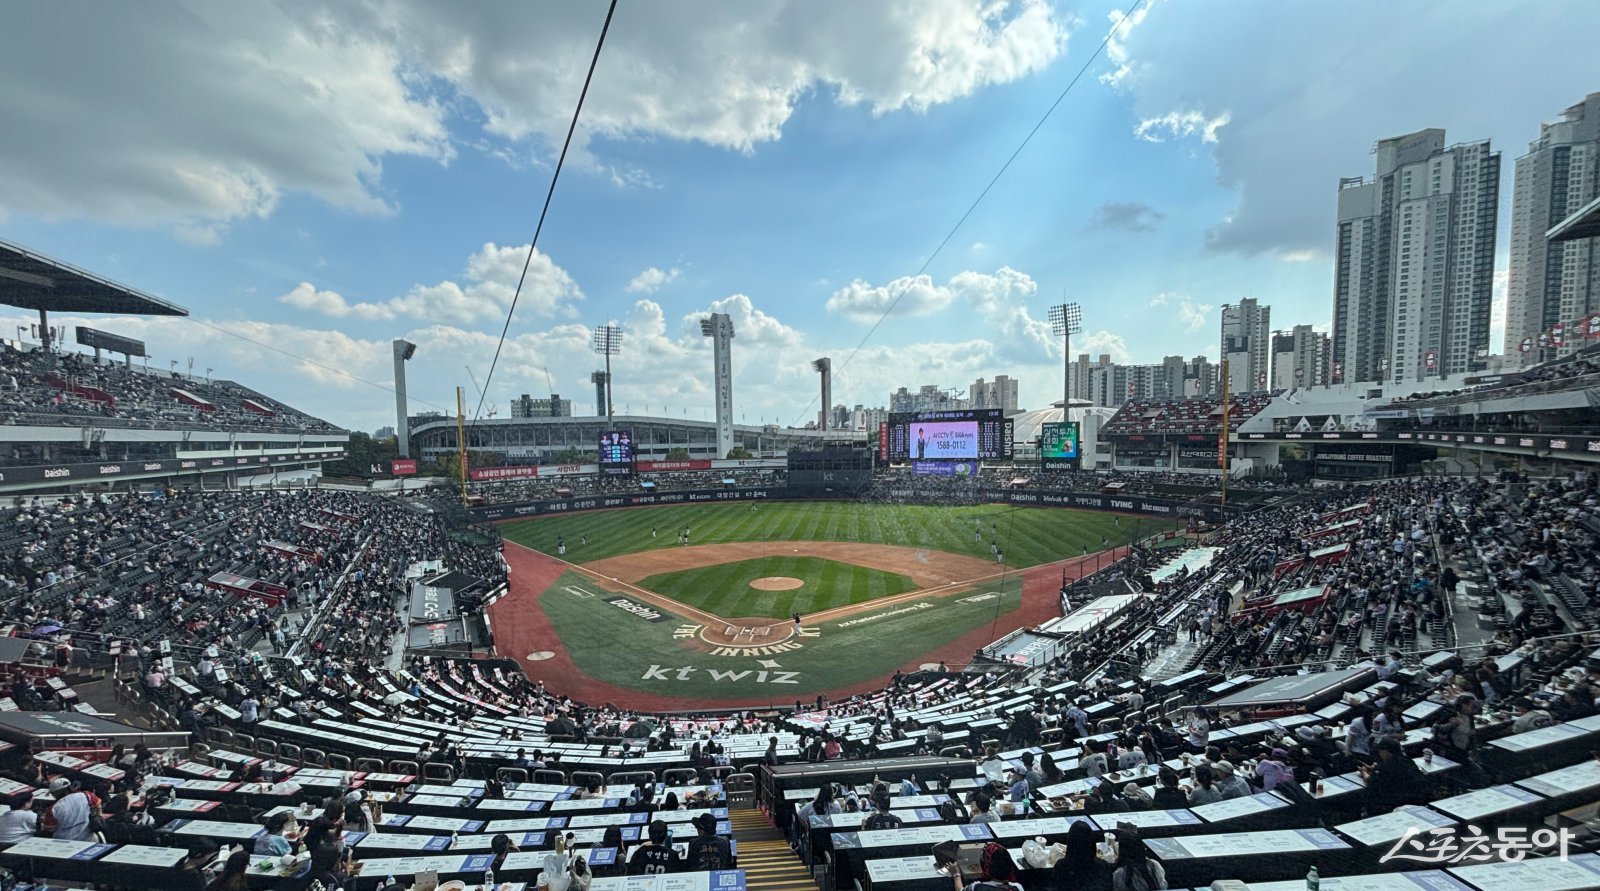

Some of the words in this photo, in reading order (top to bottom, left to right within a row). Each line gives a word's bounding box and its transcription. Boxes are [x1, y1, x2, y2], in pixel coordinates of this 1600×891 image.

[1004, 422, 1012, 456] Daishin
[936, 441, 966, 449] 1588-0112
[1365, 454, 1393, 462] ROASTERS
[100, 465, 121, 474] Daishin
[144, 463, 161, 471] Daishin
[371, 463, 383, 474] kt
[44, 468, 70, 477] Daishin
[823, 471, 834, 481] kt
[1011, 493, 1037, 501] Daishin
[1110, 500, 1134, 509] TVING
[1141, 502, 1152, 511] bhc
[609, 599, 661, 620] Daishin
[673, 624, 703, 640] THE
[709, 640, 804, 657] INNING
[641, 664, 698, 681] kt
[706, 659, 801, 684] wiz
